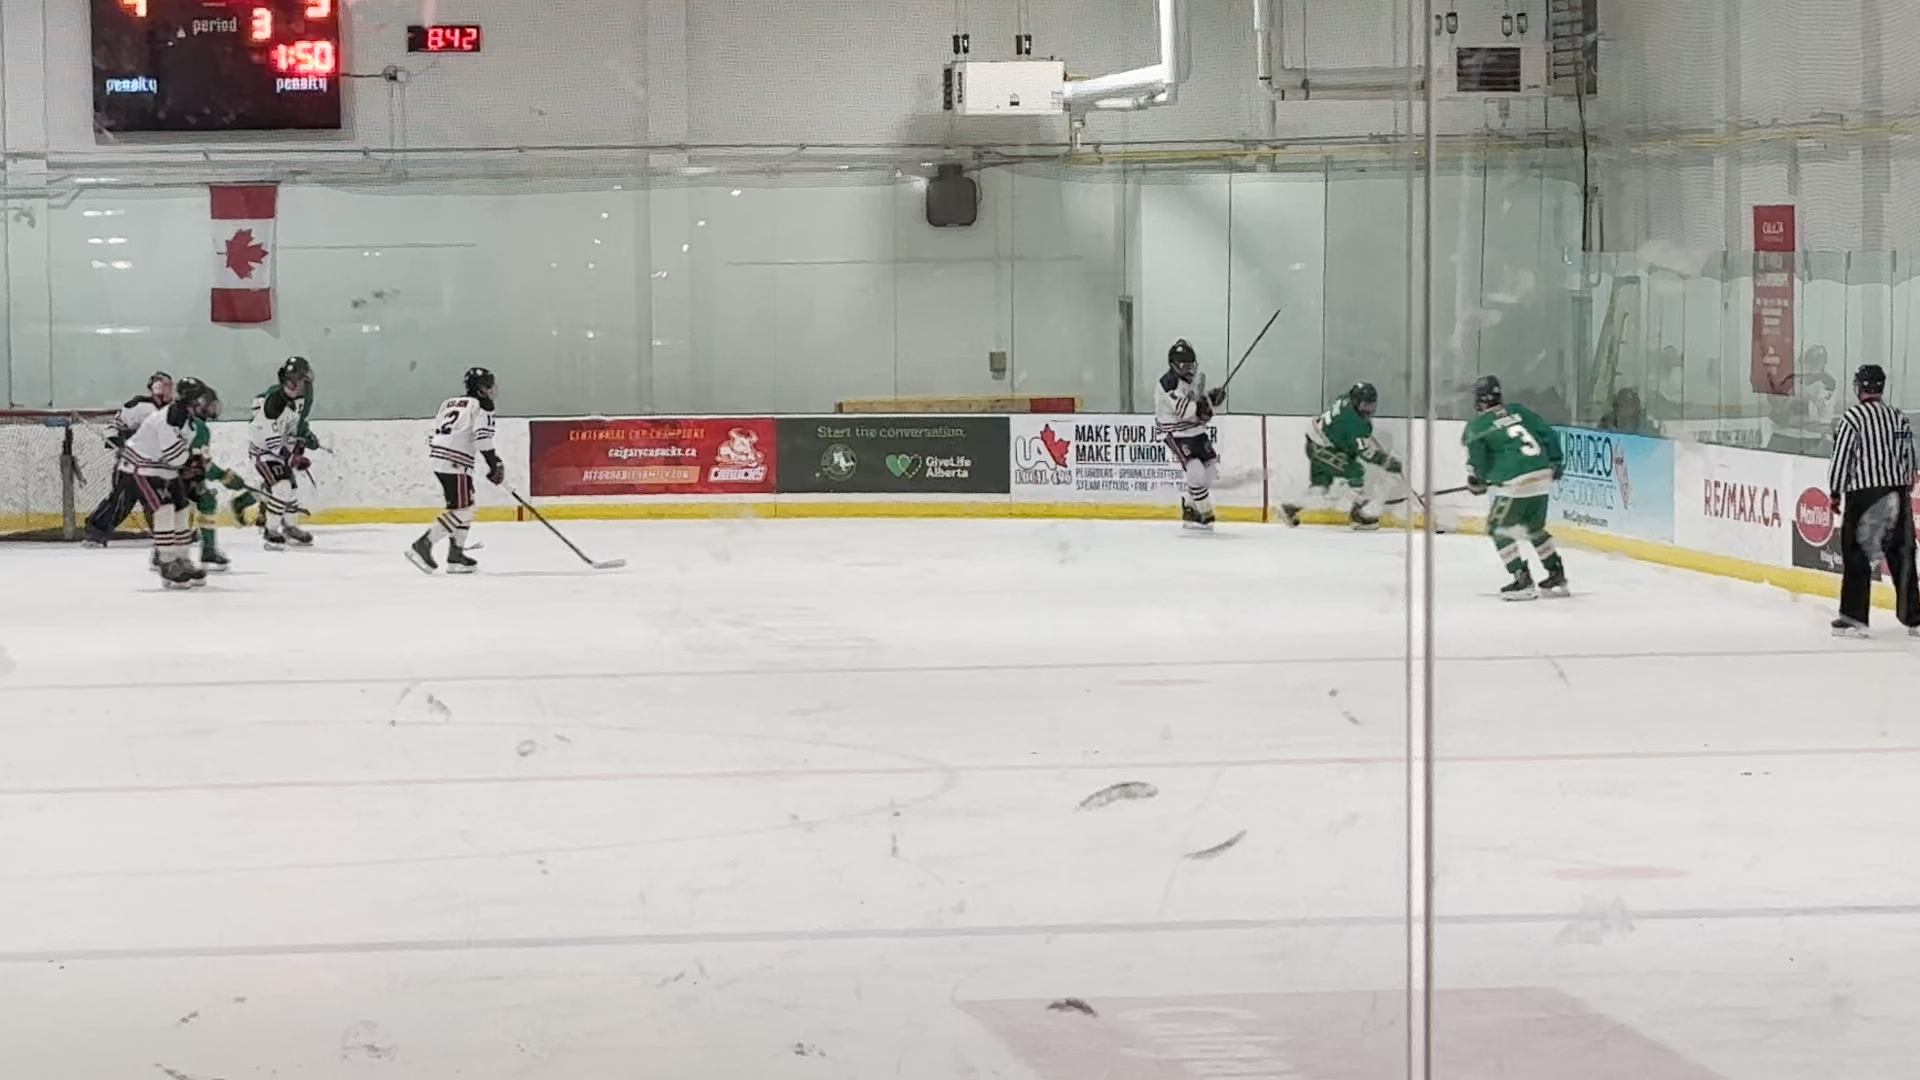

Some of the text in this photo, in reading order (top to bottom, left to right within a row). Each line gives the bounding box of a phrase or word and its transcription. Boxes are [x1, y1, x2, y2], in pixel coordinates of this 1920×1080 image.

[192, 17, 238, 36] period
[252, 7, 272, 40] 3
[272, 40, 335, 73] 1:50
[106, 76, 158, 95] penalty
[276, 76, 327, 93] penalty
[817, 425, 851, 439] Start
[855, 425, 877, 438] the
[1075, 424, 1111, 443] MAKE
[1114, 425, 1146, 443] YOUR
[1507, 424, 1541, 456] 3
[925, 456, 972, 468] GiveLife
[1075, 444, 1112, 463] MAKE
[1114, 444, 1125, 462] IT
[925, 468, 969, 479] Alberta
[1703, 478, 1782, 529] RE/MAX.CA
